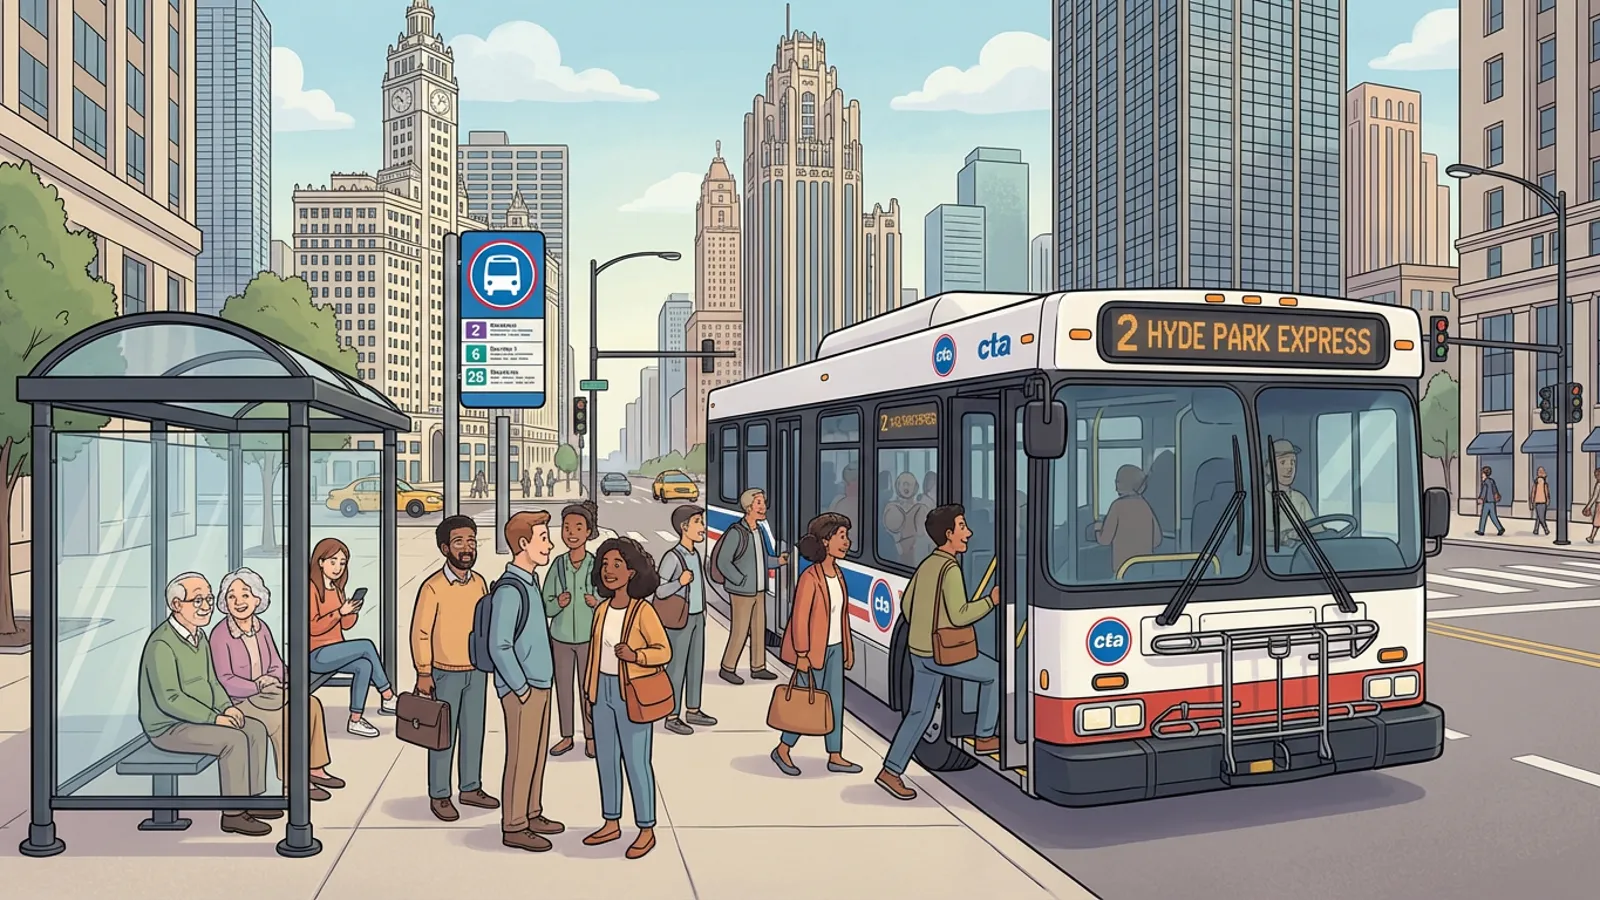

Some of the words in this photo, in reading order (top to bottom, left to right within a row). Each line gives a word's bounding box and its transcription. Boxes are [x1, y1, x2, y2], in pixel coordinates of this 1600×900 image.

[471, 324, 480, 337] 2
[1116, 313, 1138, 352] 2
[1147, 319, 1206, 350] HYDE
[1212, 322, 1271, 352] PARK
[1277, 325, 1372, 355] EXPRESS
[471, 347, 480, 360] 6
[978, 332, 1011, 360] cta
[936, 347, 952, 362] cta
[467, 370, 484, 383] 28
[880, 414, 888, 431] 2
[1093, 632, 1124, 649] cta
